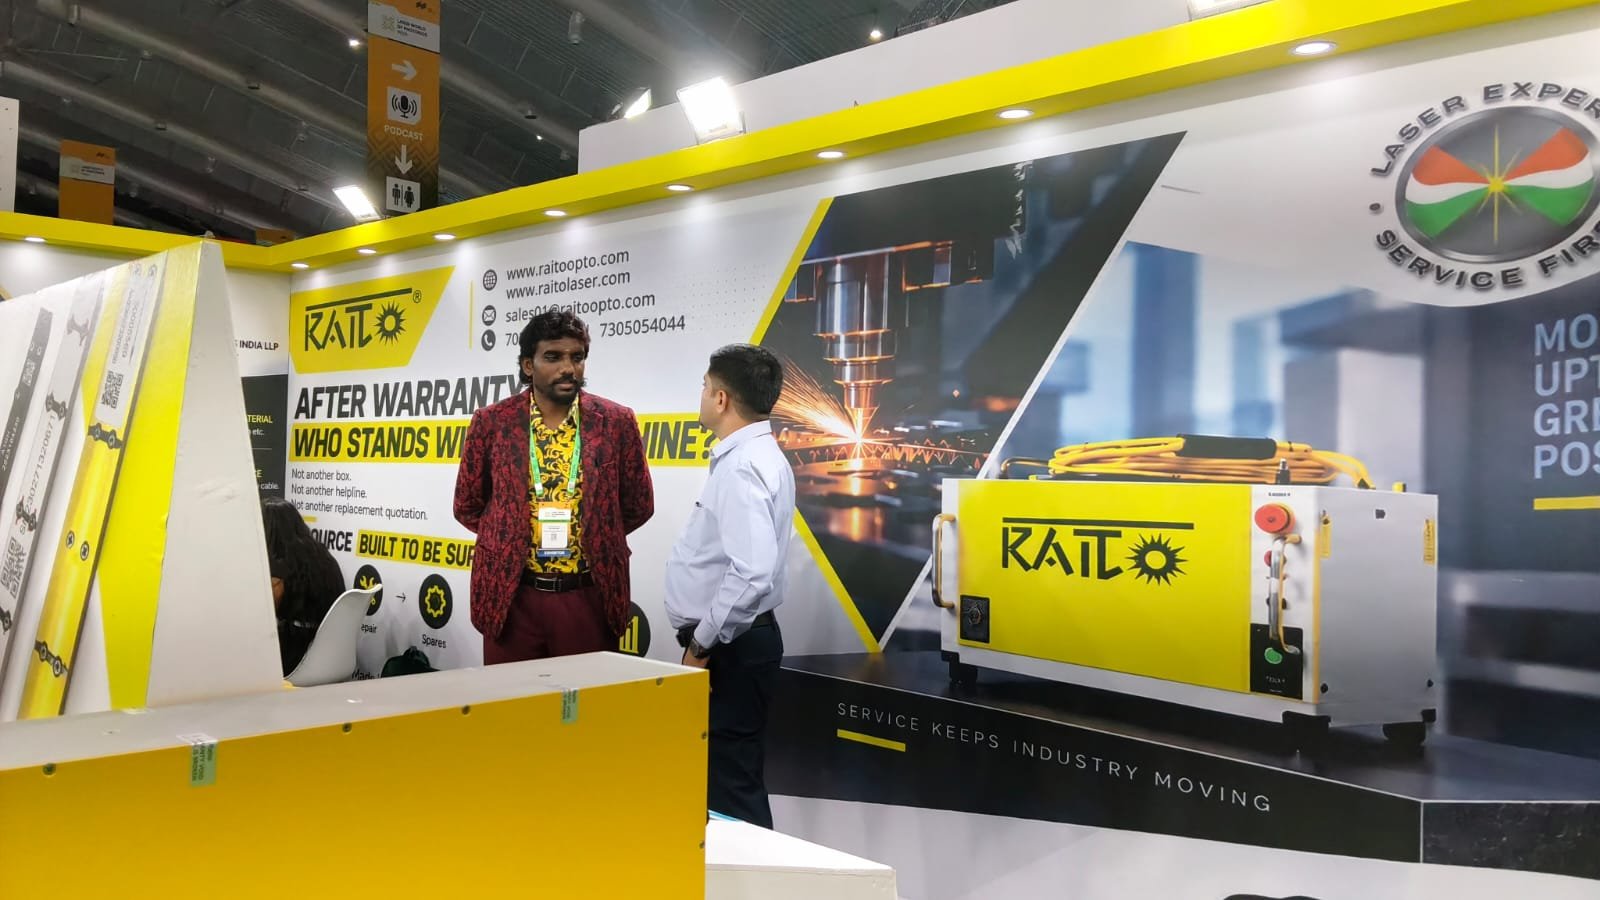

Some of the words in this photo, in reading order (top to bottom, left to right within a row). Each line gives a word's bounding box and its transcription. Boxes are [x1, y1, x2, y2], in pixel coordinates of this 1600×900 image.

[384, 124, 424, 143] PODCAST
[1371, 95, 1467, 178] LASER
[506, 250, 629, 281] www.raitoopto.com
[1376, 229, 1523, 289] SERVICE
[1538, 220, 1600, 275] FIR
[506, 271, 631, 299] www.raitolaser.com
[600, 315, 686, 337] 7305054044
[1534, 313, 1600, 357] MO
[240, 340, 262, 350] INDIA
[264, 341, 279, 351] LLP
[294, 384, 367, 419] AFTER
[248, 414, 273, 423] TERIAL
[294, 427, 343, 458] WHO
[347, 426, 431, 458] STANDS
[436, 425, 467, 458] WI
[291, 468, 304, 480] Not
[306, 469, 334, 481] another
[335, 470, 352, 481] box.
[291, 483, 304, 495] Not
[305, 485, 333, 497] another
[335, 486, 367, 500] helpline.
[305, 500, 333, 513] another
[335, 502, 383, 518] replacement
[385, 507, 428, 521] quotation.
[310, 528, 353, 552] OURCE
[359, 533, 399, 558] BUILT
[401, 538, 418, 560] TO
[422, 540, 442, 563] BE
[361, 623, 377, 634] epair
[422, 634, 447, 649] Spares
[837, 702, 920, 731] SERVICE
[932, 722, 1000, 749] KEEPS
[1013, 740, 1138, 780] INDUSTRY
[1154, 771, 1271, 812] MOVING
